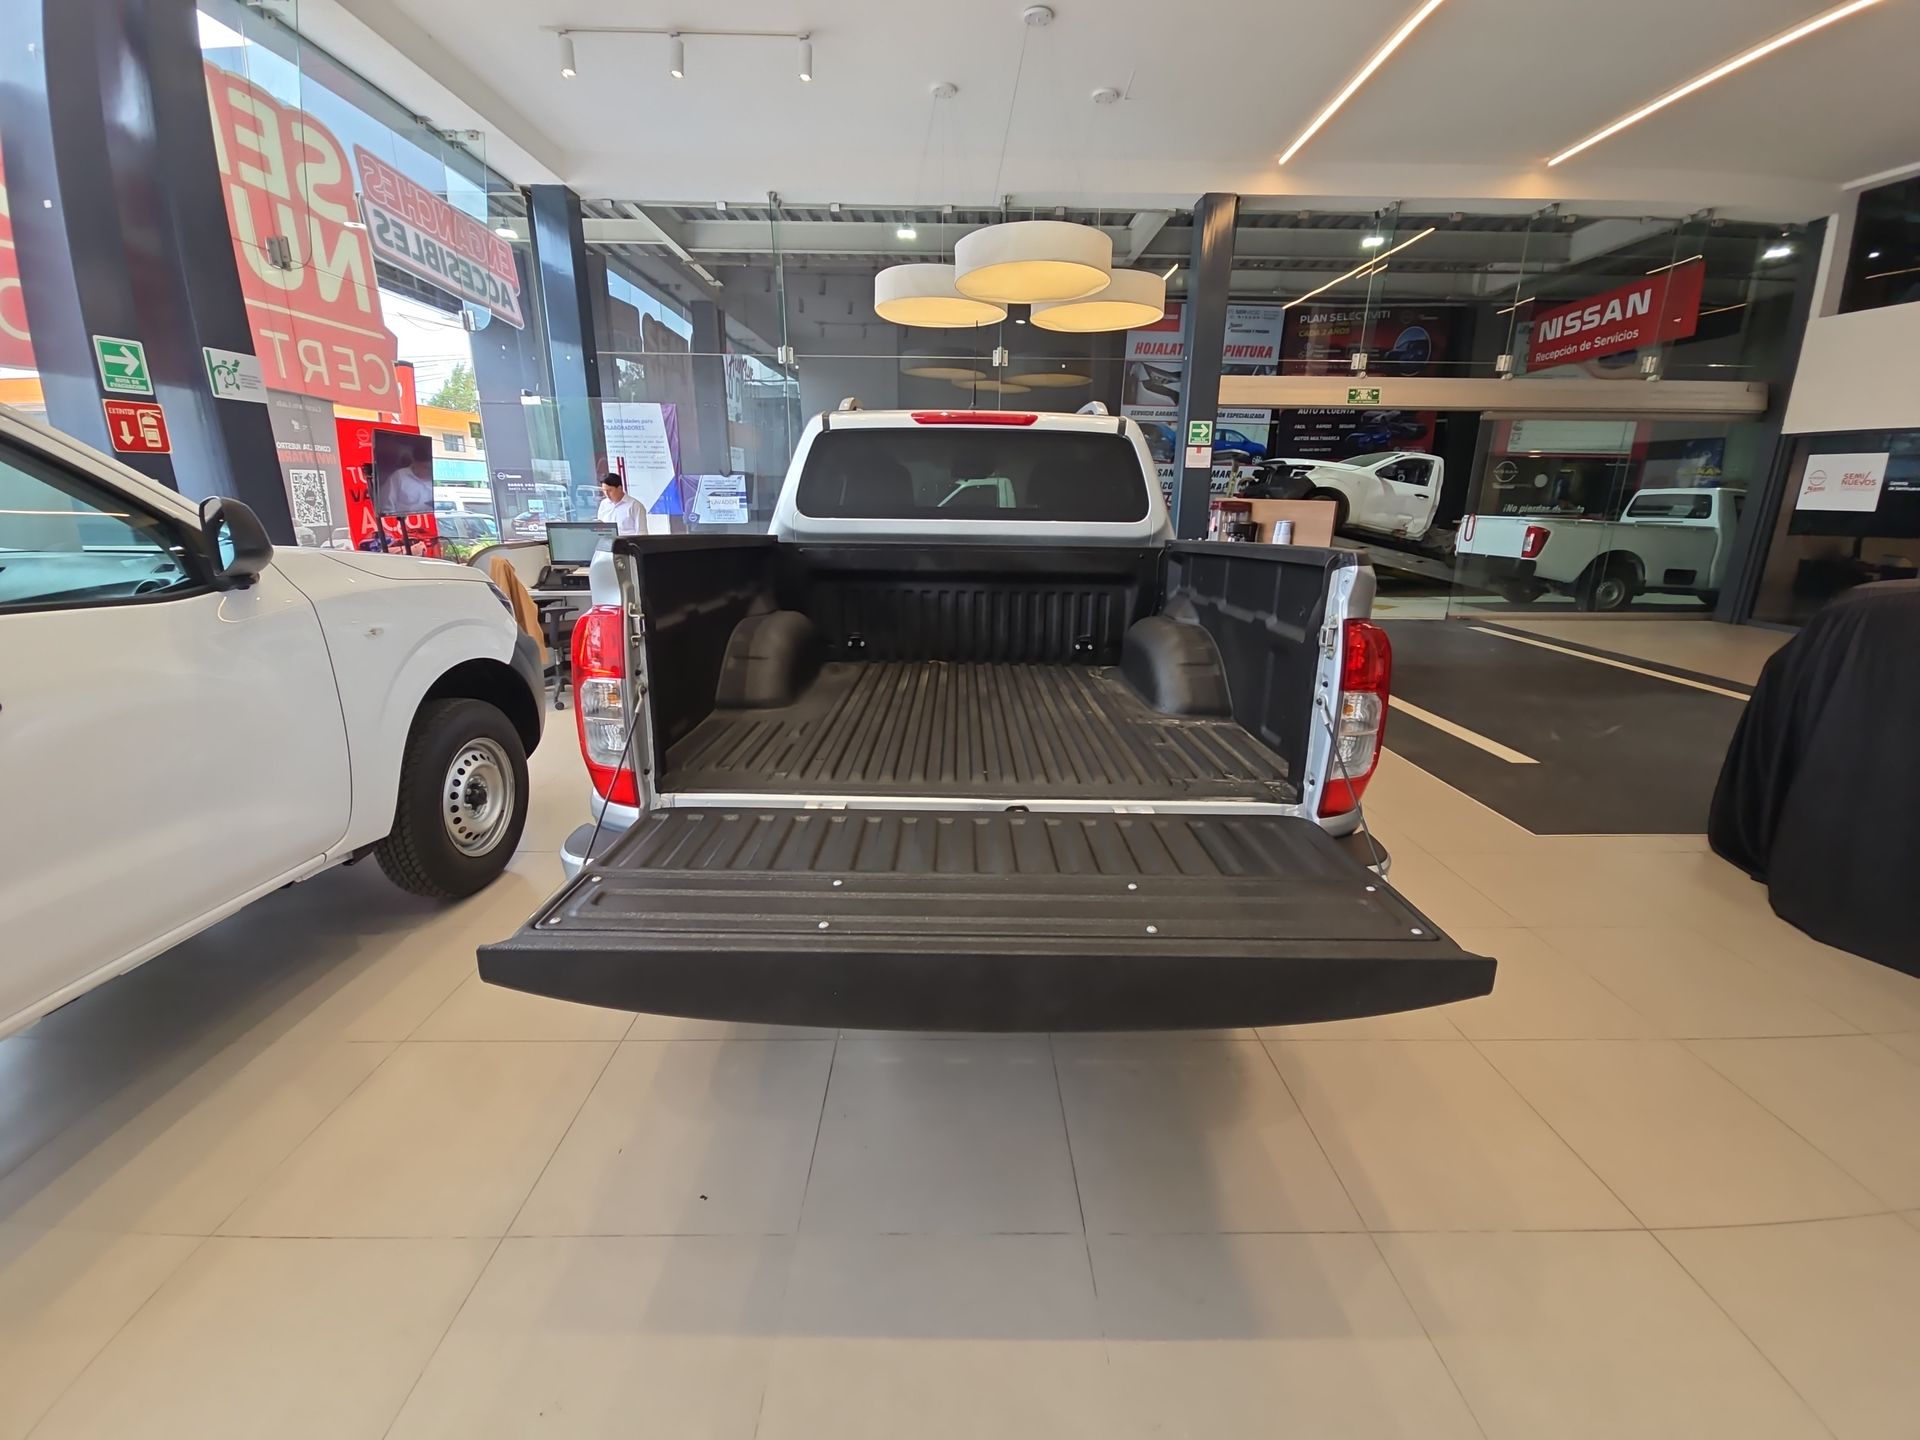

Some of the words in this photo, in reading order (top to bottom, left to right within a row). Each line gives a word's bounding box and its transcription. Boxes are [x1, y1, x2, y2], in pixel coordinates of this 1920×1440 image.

[1300, 314, 1328, 323] PLAN
[1538, 288, 1652, 343] NISSAN
[1135, 342, 1184, 355] HOJALAT
[1223, 345, 1273, 358] PINTURA
[1536, 344, 1578, 363] Recepción
[1579, 341, 1592, 351] de
[1594, 329, 1639, 349] Servicios
[108, 407, 135, 416] EXTINTOR
[1211, 470, 1243, 478] MARA
